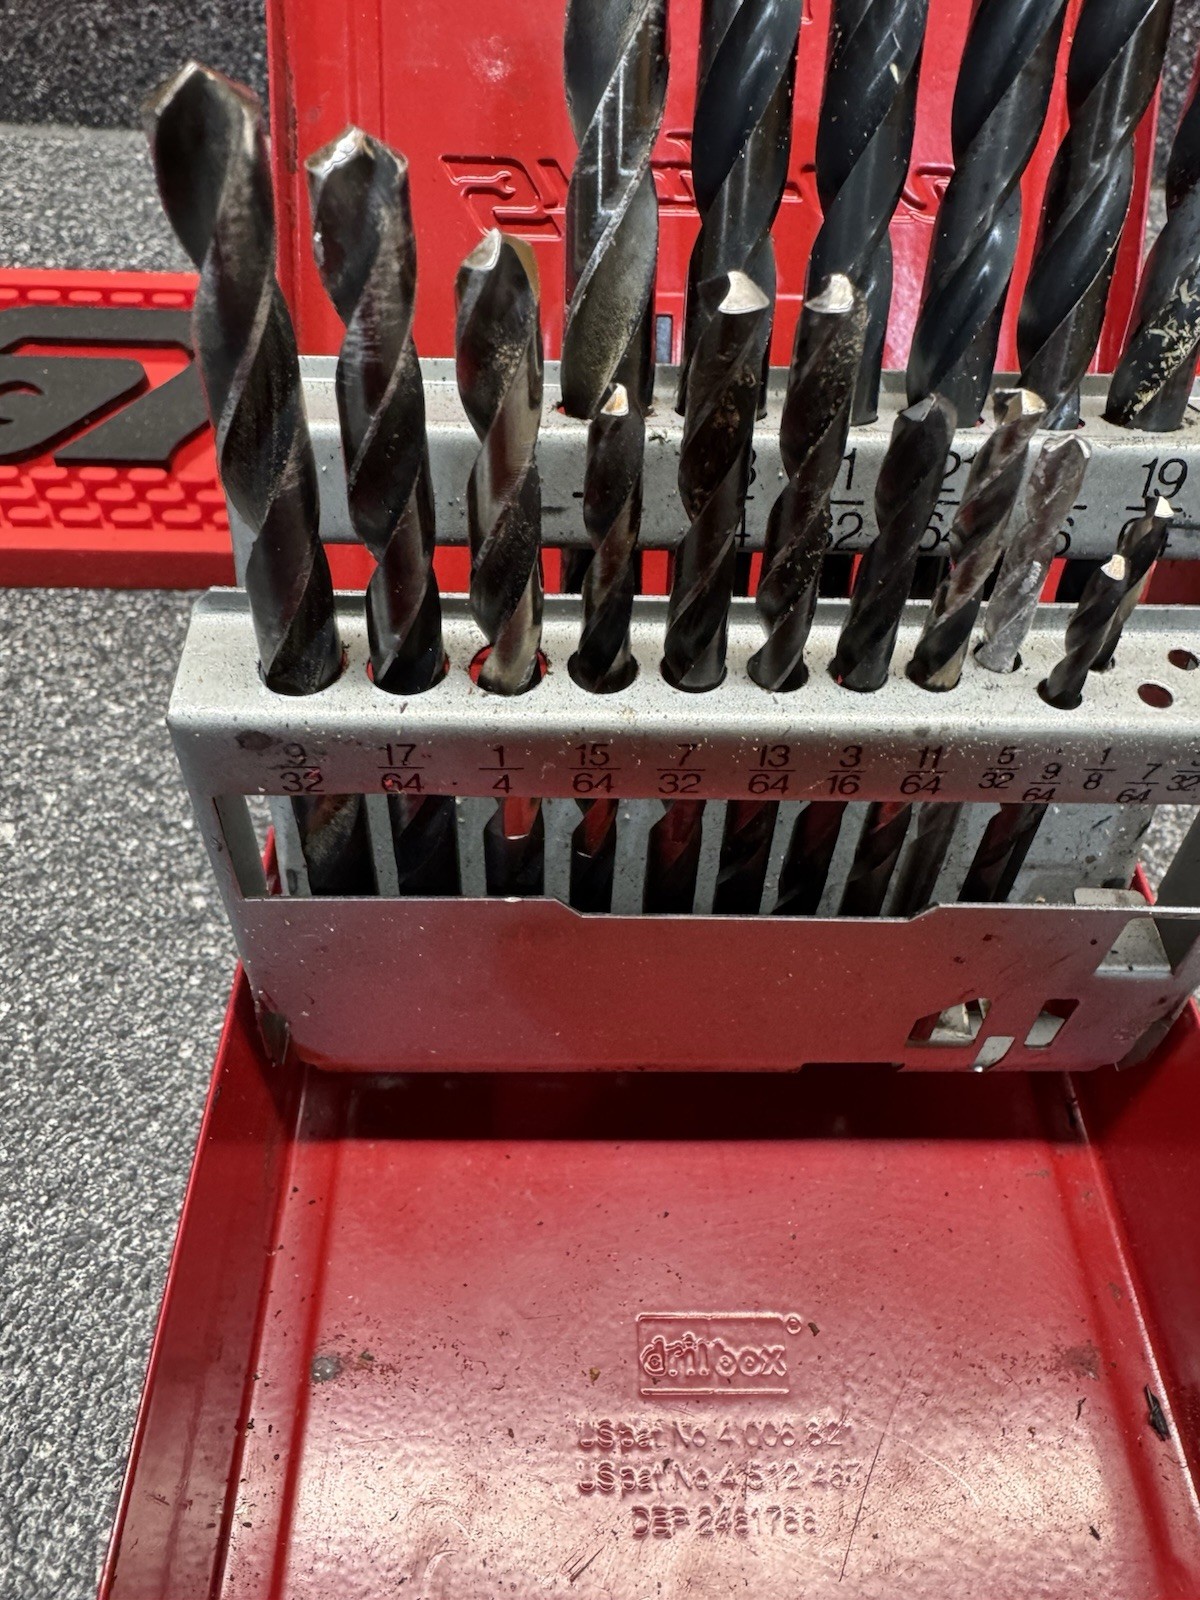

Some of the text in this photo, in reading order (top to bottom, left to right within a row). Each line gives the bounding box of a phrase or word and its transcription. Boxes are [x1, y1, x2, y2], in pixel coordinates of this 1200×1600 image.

[1142, 457, 1188, 499] 19
[379, 743, 416, 765] 17
[493, 745, 505, 767] 1
[575, 743, 610, 766] 15
[676, 743, 700, 766] 7
[757, 745, 790, 768] 13
[839, 745, 863, 768] 3
[919, 745, 943, 769] 11
[997, 746, 1017, 765] 5
[1100, 747, 1112, 765] 1
[978, 772, 1015, 789] 32
[1042, 762, 1062, 780] 9
[1083, 772, 1103, 790] 8
[1141, 763, 1163, 780] 7
[280, 772, 324, 792] 32
[382, 773, 425, 793] 64
[492, 774, 513, 793] 4
[572, 773, 615, 793] 64
[658, 773, 701, 793] 32
[748, 773, 789, 794] 64
[827, 774, 861, 794] 16
[900, 774, 941, 795] 64
[1022, 787, 1056, 802] 64
[1116, 789, 1152, 803] 64
